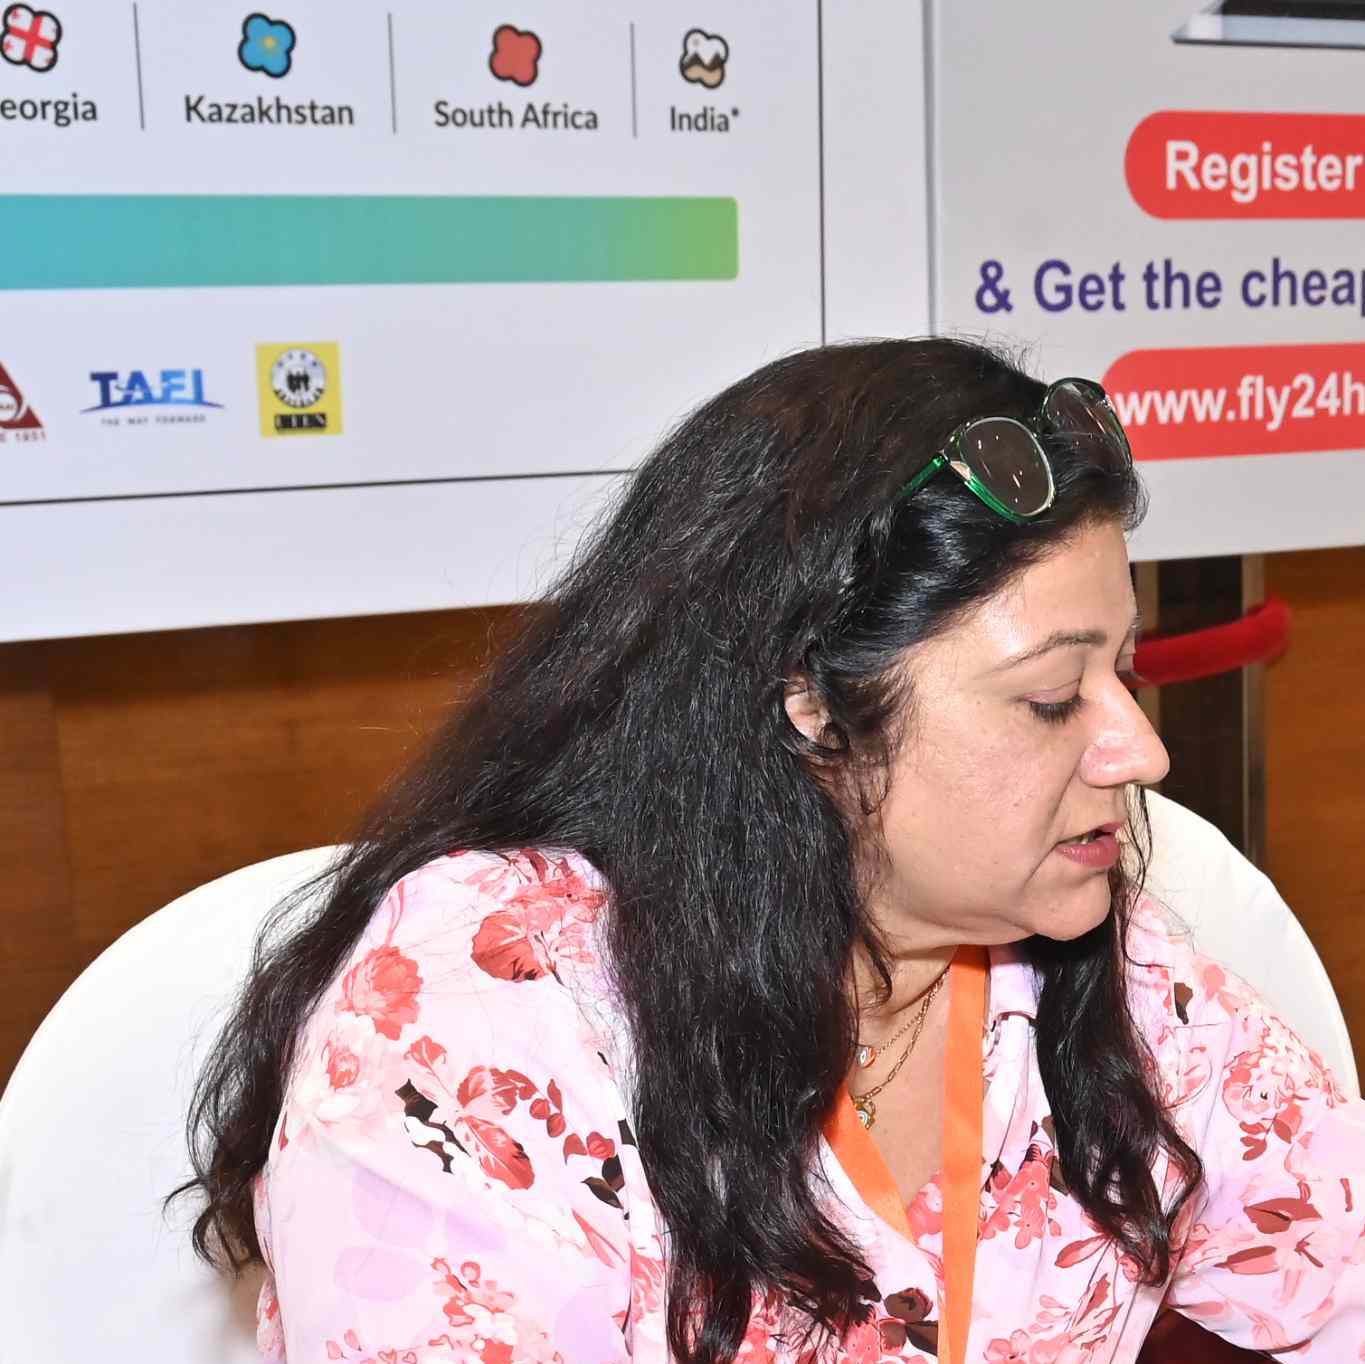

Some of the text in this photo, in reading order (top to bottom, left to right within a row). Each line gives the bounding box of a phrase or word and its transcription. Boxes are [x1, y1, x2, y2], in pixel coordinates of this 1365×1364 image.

[0, 92, 97, 127] eorgia
[184, 94, 354, 125] Kazakhstan
[434, 100, 599, 131] South Africa
[1164, 139, 1362, 203] Register
[974, 259, 1013, 313] &
[1033, 258, 1126, 312] Get
[1142, 257, 1223, 310] the
[90, 368, 204, 408] TAFI
